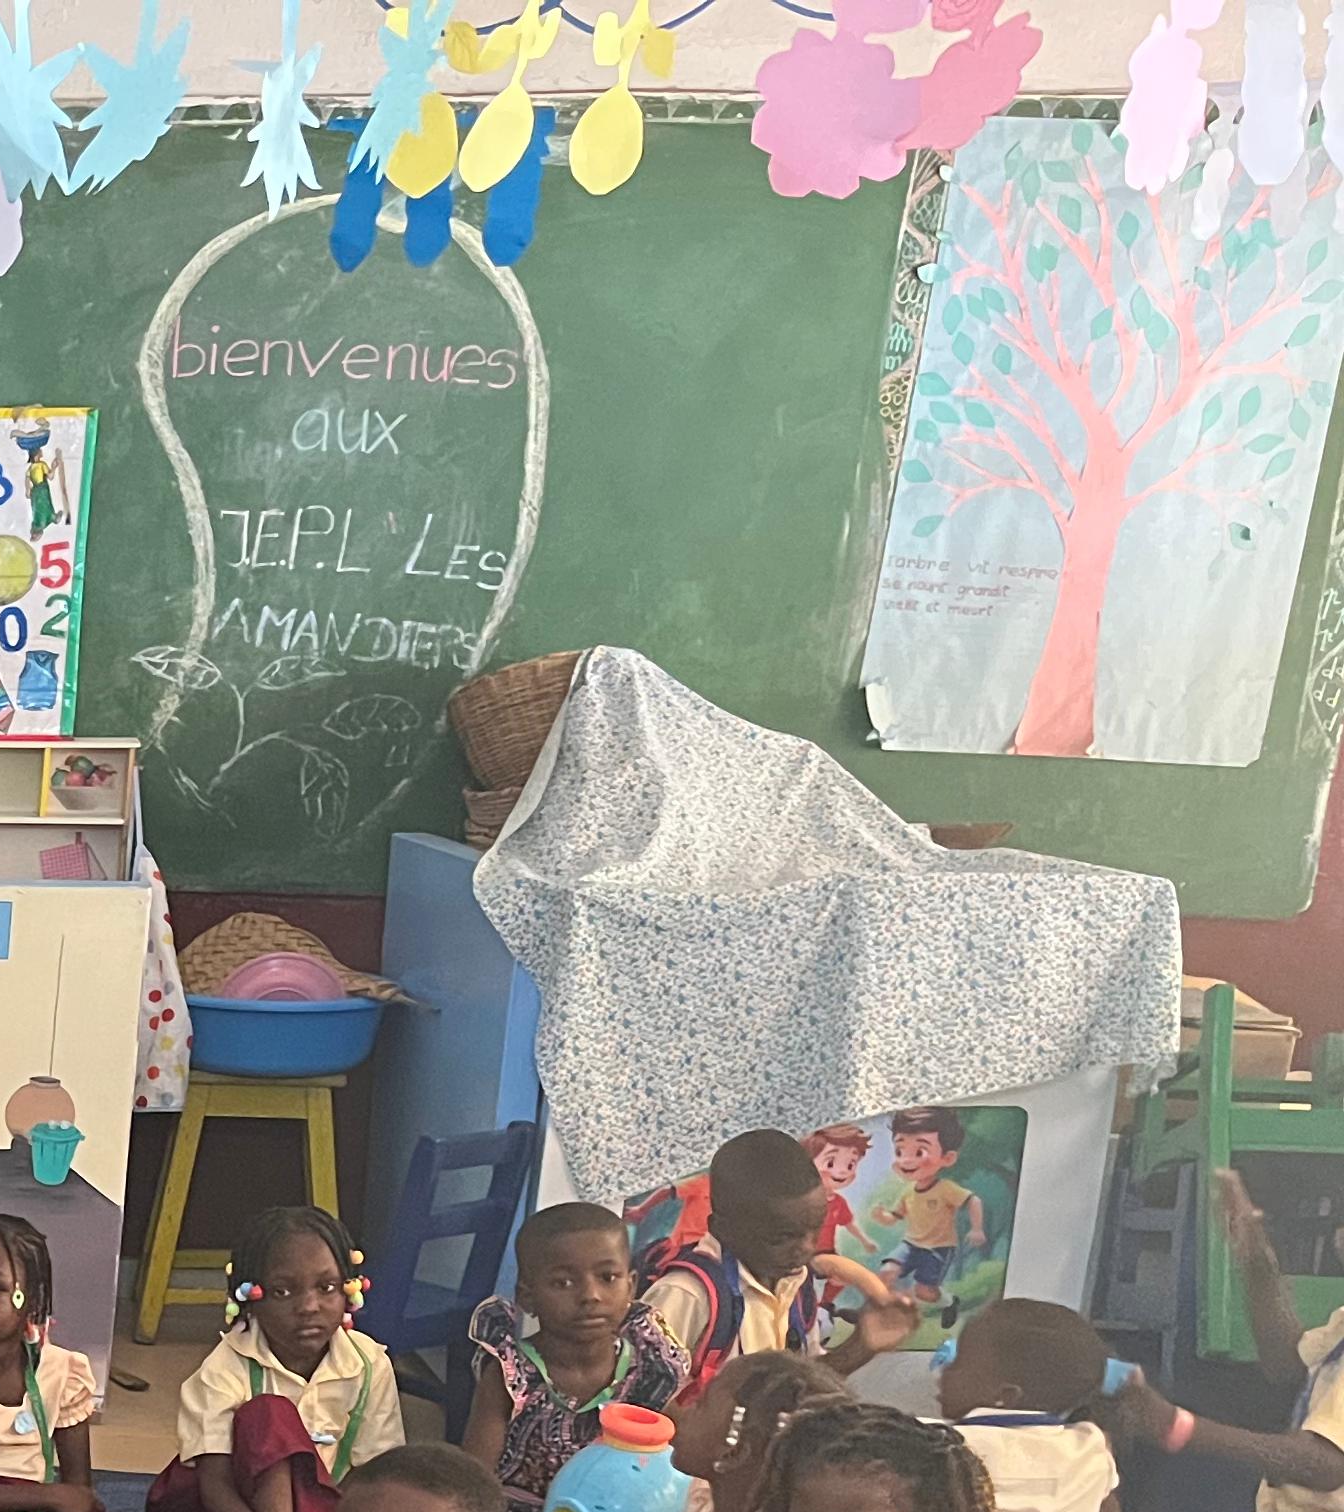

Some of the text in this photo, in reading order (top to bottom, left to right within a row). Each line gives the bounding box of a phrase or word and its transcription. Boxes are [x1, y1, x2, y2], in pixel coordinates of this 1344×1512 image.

[171, 314, 519, 389] bienvenues
[291, 408, 408, 455] aux
[39, 541, 72, 589] 5
[40, 592, 72, 638] 2
